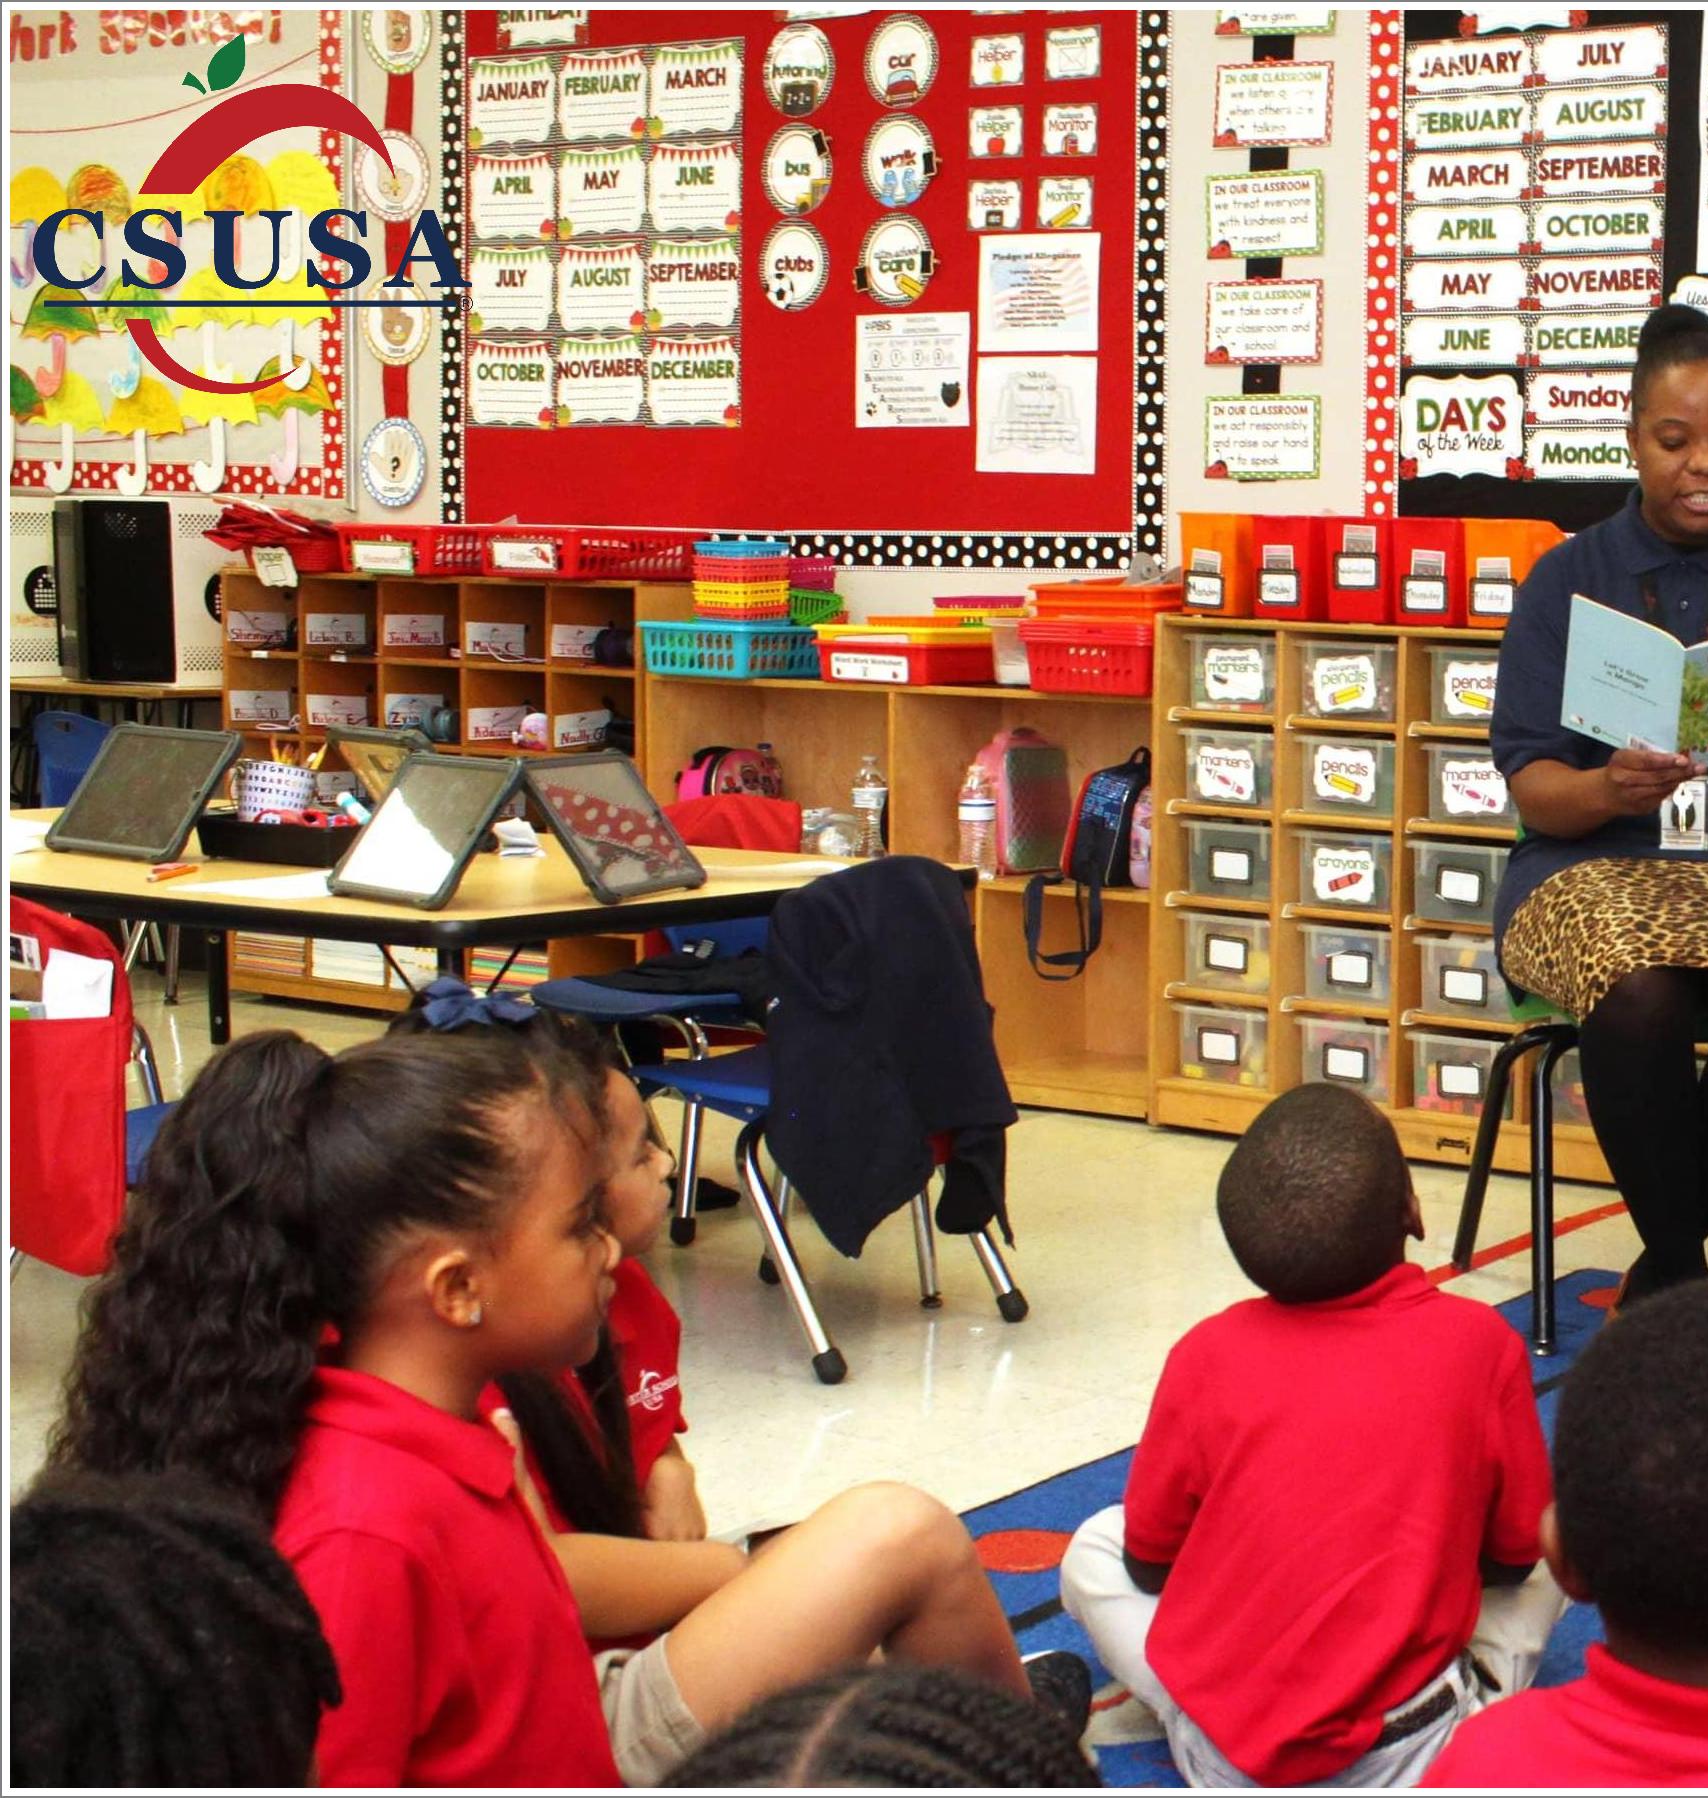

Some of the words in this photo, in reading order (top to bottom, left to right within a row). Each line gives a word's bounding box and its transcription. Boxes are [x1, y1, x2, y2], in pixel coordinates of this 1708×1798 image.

[1050, 35, 1096, 47] Messenger
[888, 53, 916, 68] car
[978, 49, 1016, 64] Helper
[1578, 42, 1625, 66] JULY
[1419, 51, 1522, 78] JANUARY
[565, 74, 640, 95] FEBRUARY
[666, 68, 726, 89] MARCH
[477, 80, 549, 101] JANUARY
[1417, 107, 1523, 134] FEBRUARY
[1557, 99, 1645, 125] AUGUST
[976, 120, 1014, 133] Helper
[1049, 119, 1093, 132] Monitor
[881, 149, 917, 168] walk
[675, 166, 714, 186] JUNE
[785, 160, 810, 176] bus
[1428, 164, 1509, 187] MARCH
[1538, 155, 1661, 181] SEPTEMBER
[493, 177, 532, 194] APRIL
[584, 170, 619, 190] MAY
[1229, 183, 1248, 194] OUR
[1252, 181, 1310, 194] CLASSROOM
[975, 194, 1014, 208] Helper
[1045, 190, 1084, 202] Monitor
[1233, 198, 1260, 209] treat
[1264, 198, 1311, 212] everyone
[1218, 216, 1240, 228] with
[1244, 215, 1286, 227] kindness
[1290, 215, 1308, 224] and
[1438, 219, 1496, 240] APRIL
[1546, 213, 1649, 237] OCTOBER
[650, 263, 737, 282] SEPTEMBER
[775, 256, 814, 272] clubs
[879, 257, 914, 272] care
[496, 270, 527, 287] JULY
[571, 268, 630, 287] AUGUST
[1441, 273, 1492, 295] MAY
[1533, 268, 1659, 294] NOVEMBER
[1230, 291, 1249, 301] OUR
[1253, 290, 1311, 301] CLASSROOM
[1240, 306, 1260, 316] take
[1264, 307, 1288, 315] care
[1215, 326, 1231, 334] our
[1235, 323, 1287, 333] classroom
[1292, 322, 1310, 332] and
[1245, 340, 1278, 350] school
[1439, 329, 1490, 350] JUNE
[1537, 326, 1640, 350] DECEMBE
[477, 363, 544, 381] OCTOBER
[557, 359, 644, 379] NOVEMBER
[652, 361, 734, 379] DECEMBER
[1549, 385, 1632, 411] Sunday
[1228, 406, 1246, 416] OUR
[1250, 406, 1308, 416] CLASSROOM
[1416, 396, 1507, 433] DAYS
[1230, 421, 1246, 431] act
[1250, 420, 1307, 433] responsibly
[1213, 439, 1230, 449] and
[1233, 439, 1258, 448] raise
[1262, 440, 1279, 448] our
[1284, 438, 1308, 448] hand
[1417, 434, 1435, 458] of
[1438, 433, 1461, 451] the
[1467, 434, 1504, 451] Week
[1251, 456, 1279, 468] speak
[1542, 443, 1635, 469] Monday
[1208, 662, 1260, 673] markers
[1321, 671, 1368, 687] pencils
[1452, 676, 1497, 692] pencils
[1201, 755, 1250, 768] markers
[1321, 760, 1368, 777] pencils
[1446, 769, 1504, 782] markers
[1318, 856, 1370, 872] crayons
